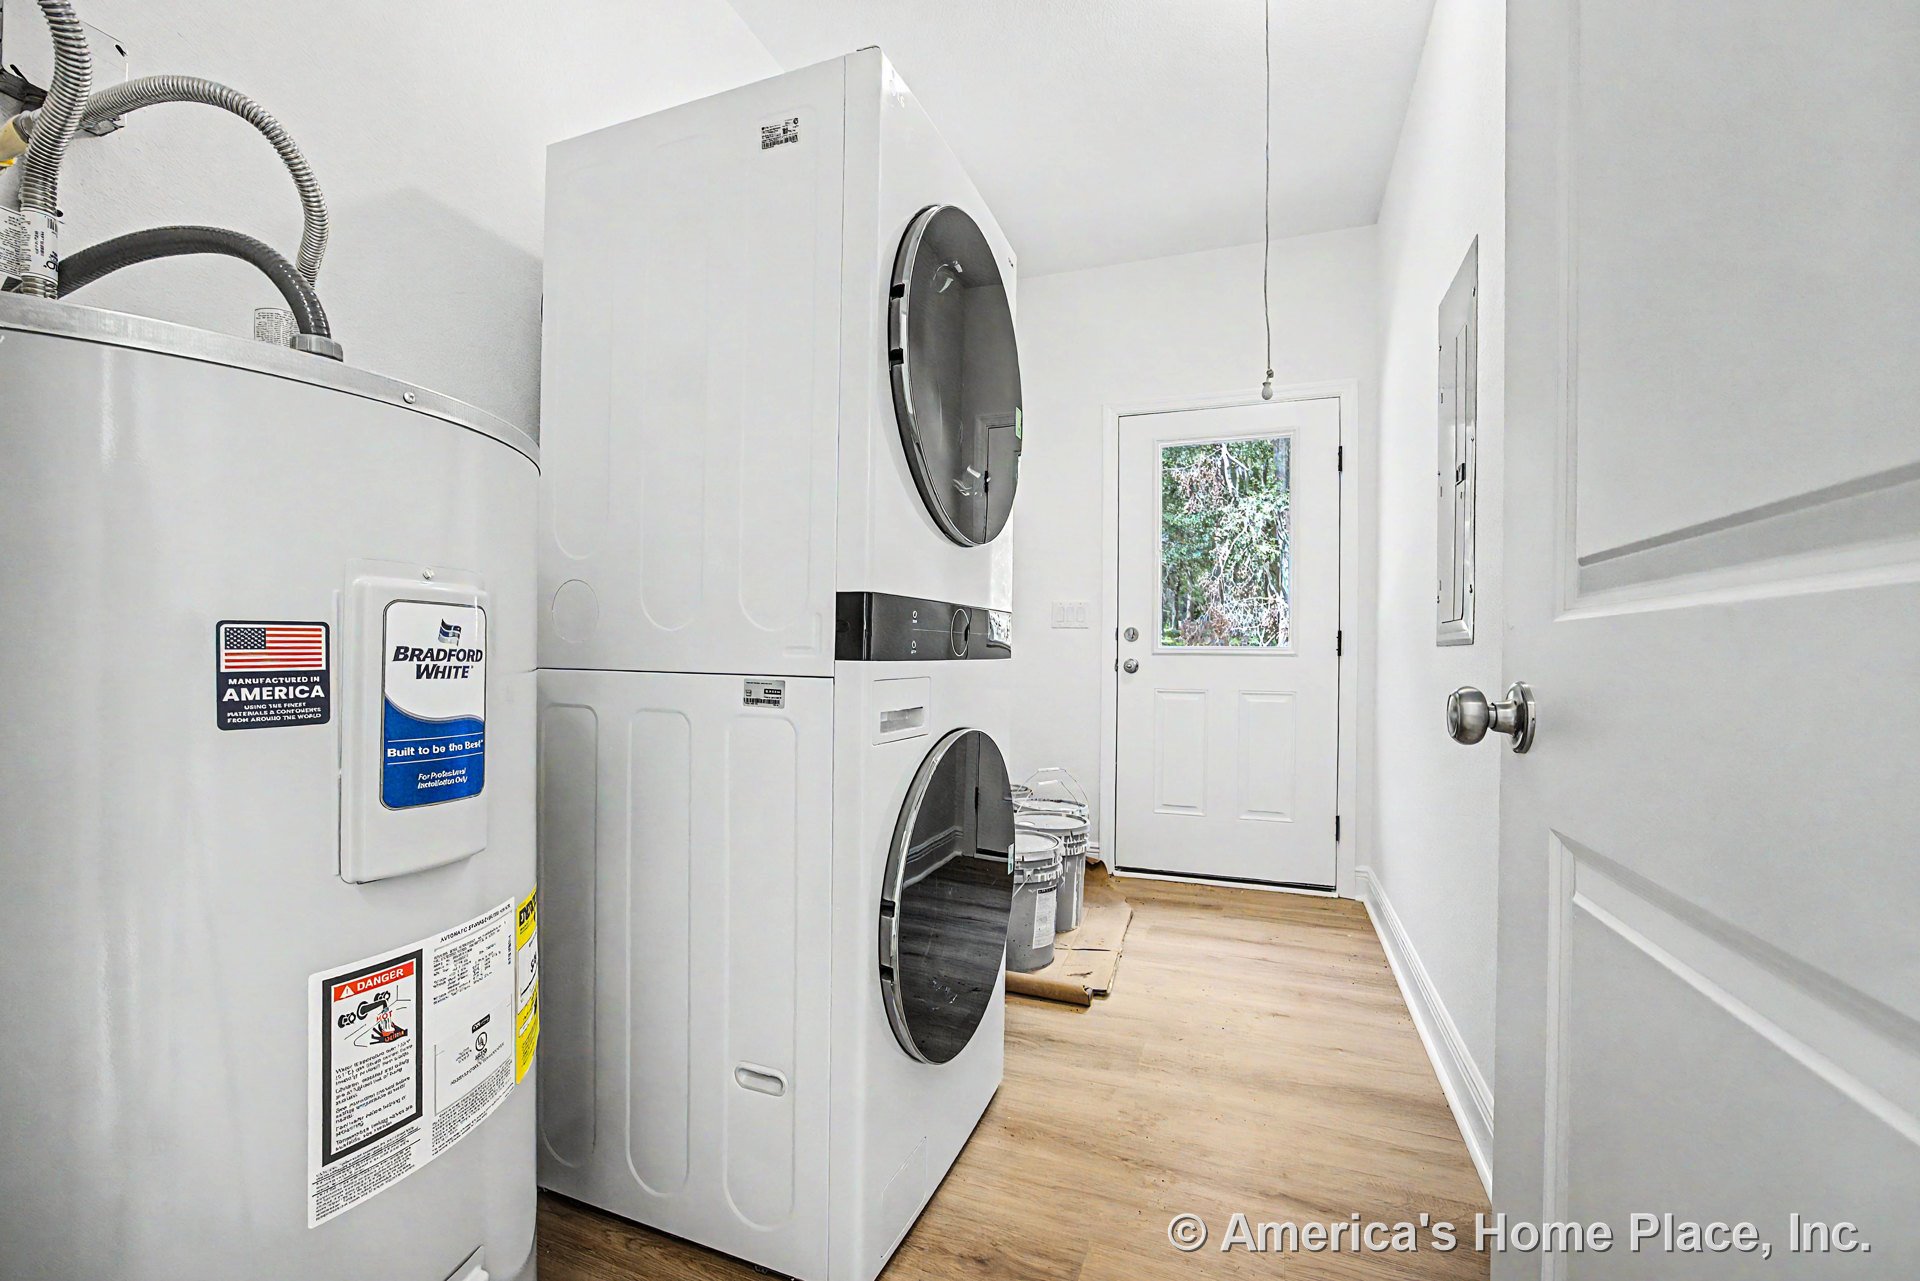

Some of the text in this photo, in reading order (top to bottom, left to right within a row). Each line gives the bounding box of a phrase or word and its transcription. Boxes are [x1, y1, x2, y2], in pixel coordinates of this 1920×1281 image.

[392, 646, 483, 662] BRADFORD
[228, 676, 308, 685] MANUFACTURED
[222, 685, 325, 702] AMERICA
[387, 747, 416, 757] Built
[418, 746, 430, 755] to
[432, 745, 446, 754] be
[449, 743, 463, 751] the
[418, 773, 430, 781] For
[357, 968, 404, 992] DANGER
[376, 1010, 392, 1022] HOT
